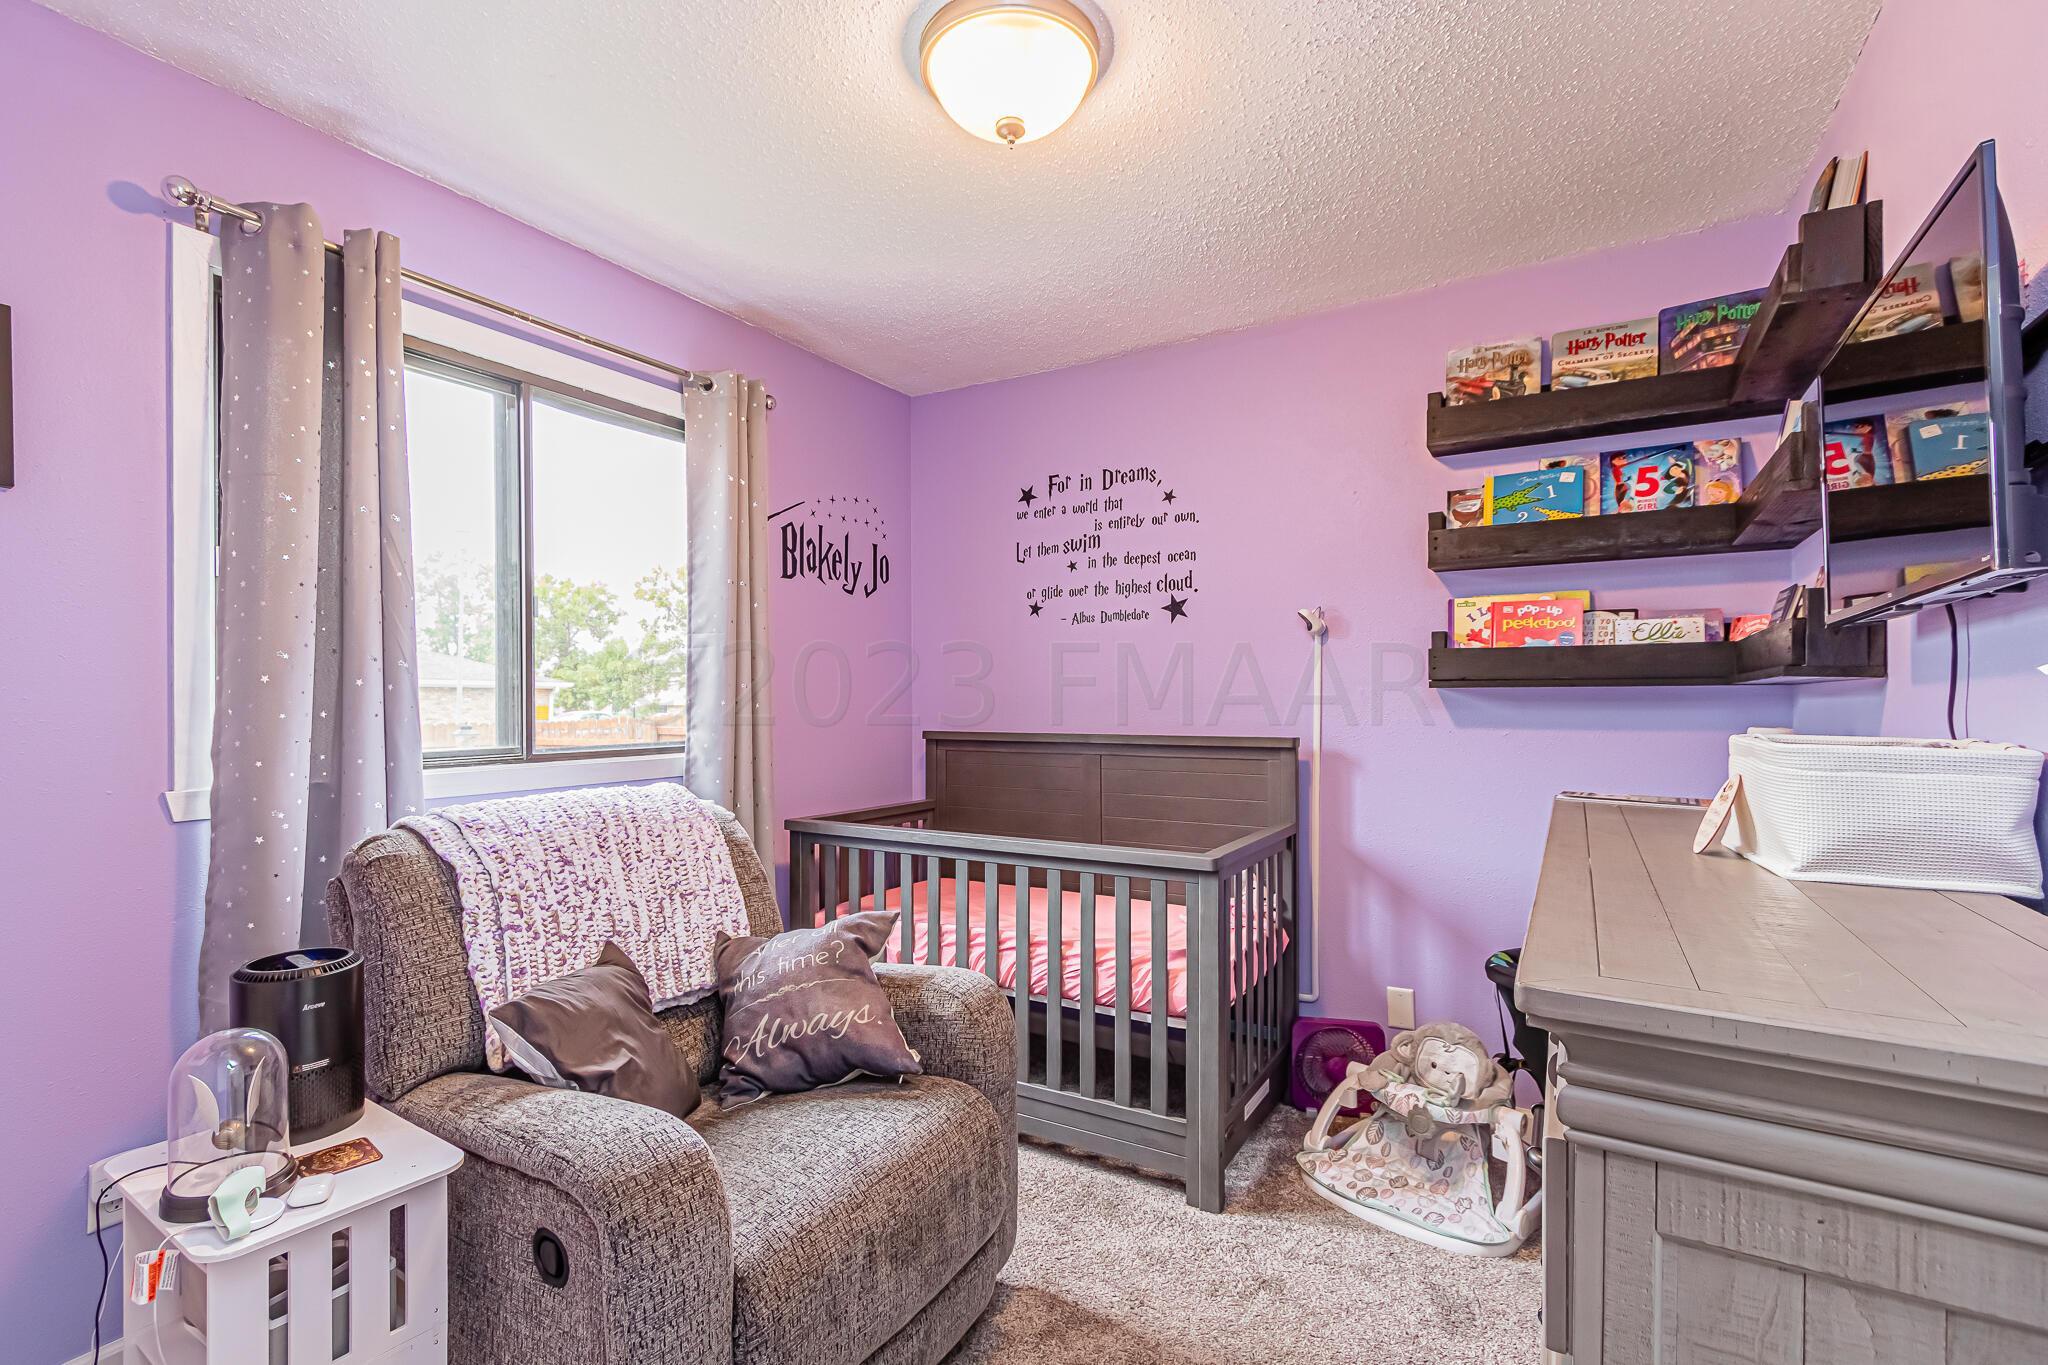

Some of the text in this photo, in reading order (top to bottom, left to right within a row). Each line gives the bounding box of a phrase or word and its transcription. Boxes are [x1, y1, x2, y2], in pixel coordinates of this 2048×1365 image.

[1565, 332, 1648, 355] Harry Potter
[1457, 350, 1530, 374] Harry Potter
[1048, 466, 1162, 502] For in Dreams,
[1546, 484, 1557, 499] 1
[1016, 496, 1124, 520] we enter a world that
[1515, 511, 1528, 523] 2
[1094, 511, 1200, 532] is entirely our own.
[780, 521, 890, 599] Blakely Jo
[1016, 533, 1101, 564] Let them swim
[1087, 550, 1197, 569] in the deepest ocean
[1026, 570, 1199, 603] or glide over the highest cloud.
[1071, 612, 1096, 626] Albus
[1100, 608, 1150, 624] Dumbledore
[734, 940, 845, 997] this time?
